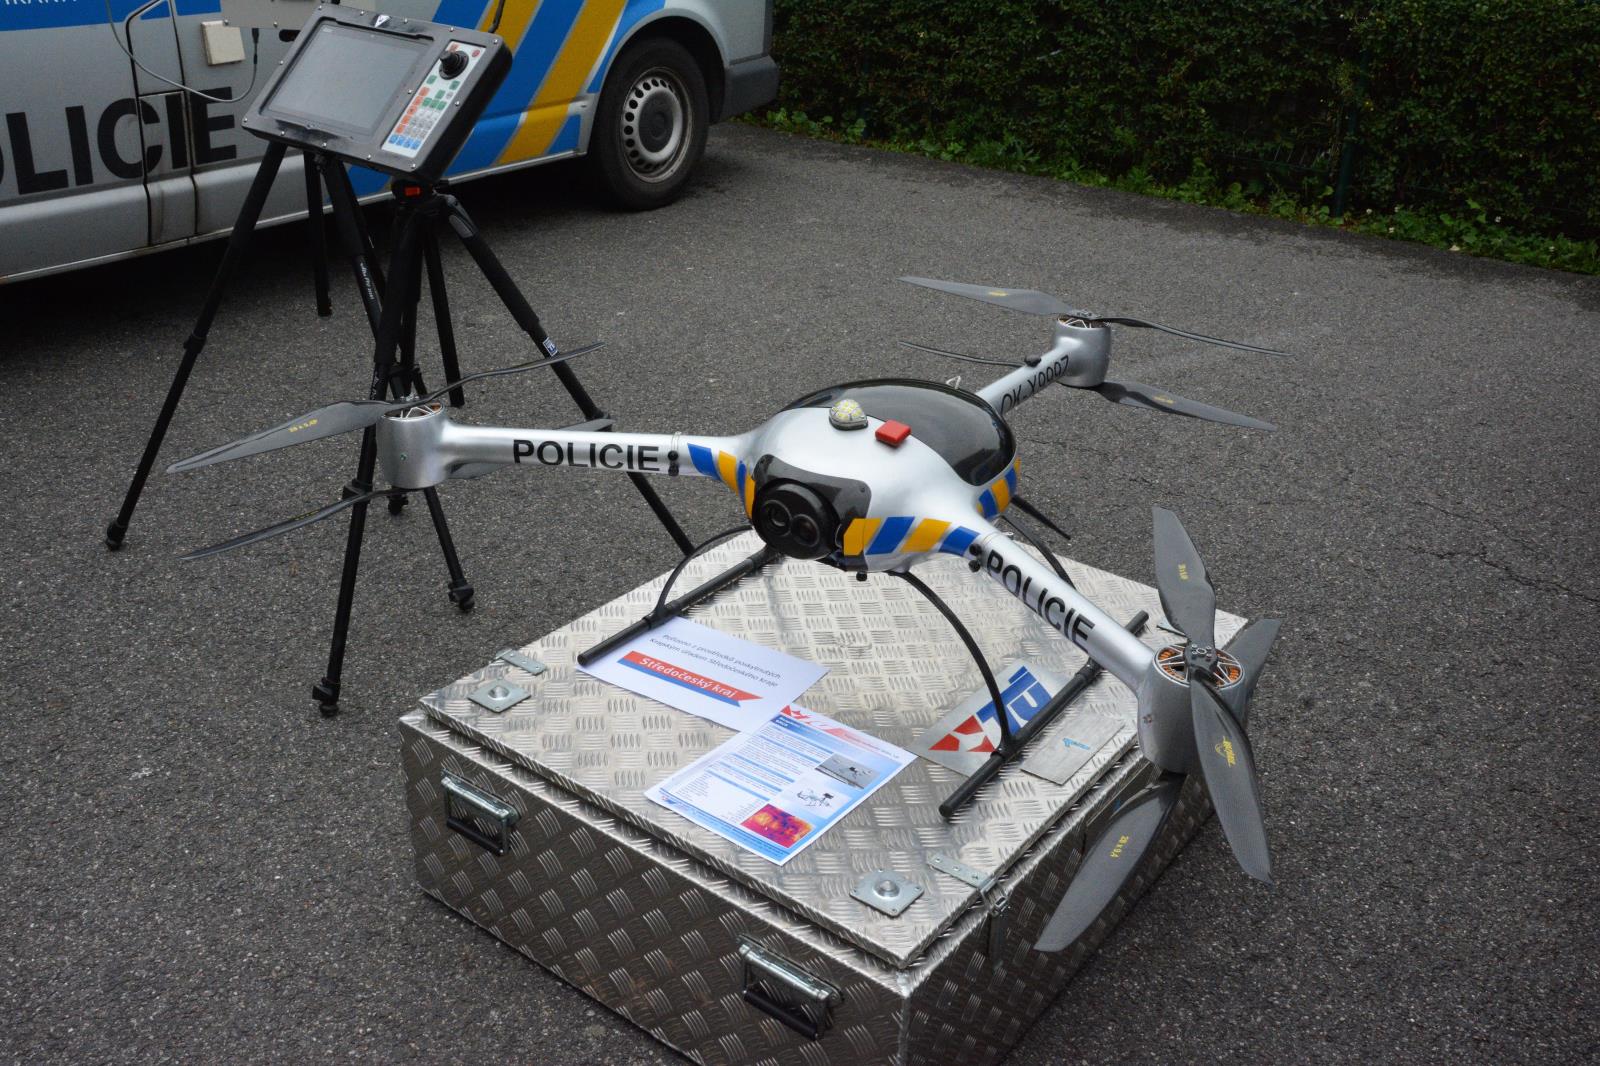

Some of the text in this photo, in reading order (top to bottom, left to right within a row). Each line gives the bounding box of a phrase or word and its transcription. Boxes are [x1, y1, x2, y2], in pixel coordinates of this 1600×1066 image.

[0, 86, 238, 195] LICIE
[513, 439, 661, 472] POLICIE
[986, 549, 1096, 654] POLICIE
[640, 657, 737, 698] Středočeský kraj
